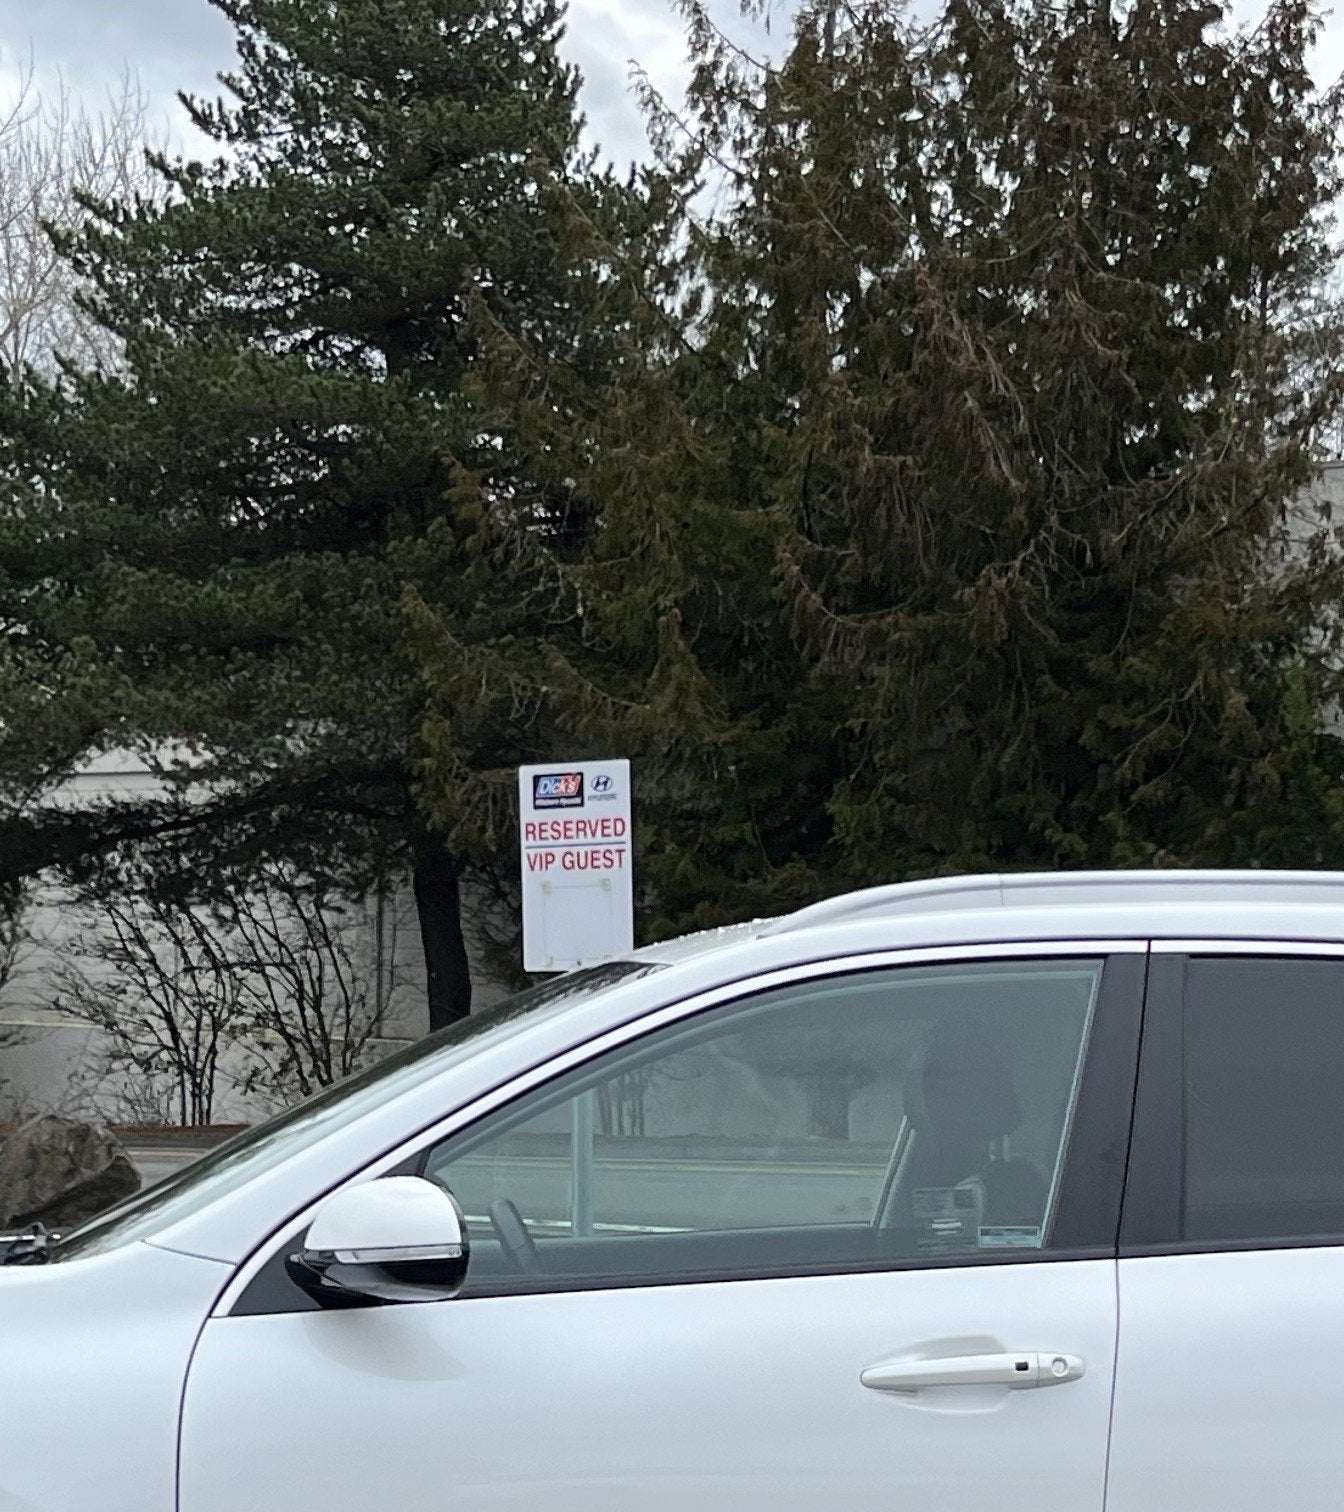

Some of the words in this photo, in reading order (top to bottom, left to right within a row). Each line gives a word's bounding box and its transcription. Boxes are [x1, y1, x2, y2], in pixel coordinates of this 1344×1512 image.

[525, 817, 627, 842] RESERVED
[525, 852, 556, 872] VIP
[561, 848, 626, 871] GUEST
